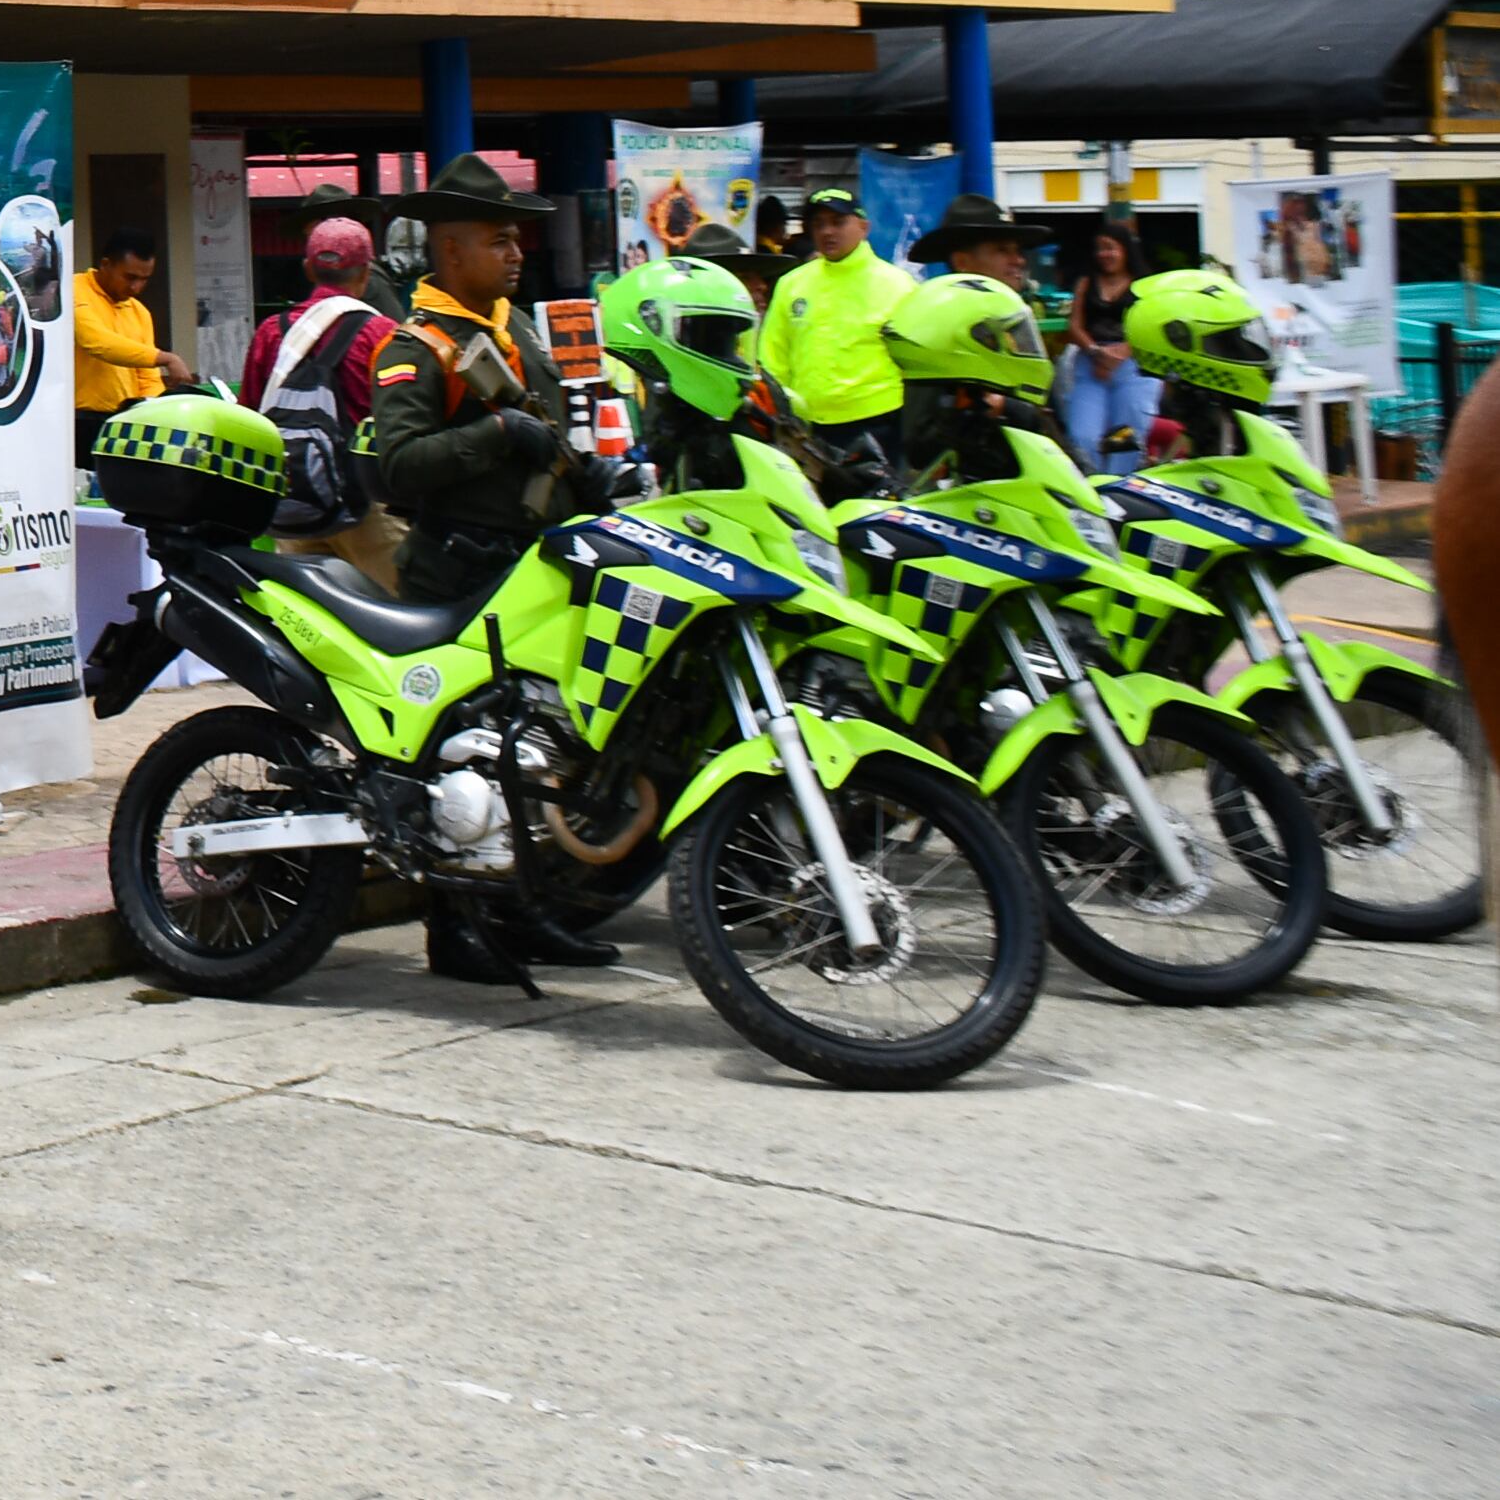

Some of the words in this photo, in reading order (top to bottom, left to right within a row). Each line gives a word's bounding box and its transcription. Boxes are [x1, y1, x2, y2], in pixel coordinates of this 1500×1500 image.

[618, 517, 736, 583] POLICÍA
[901, 510, 1023, 563] POLICÍA
[29, 618, 40, 637] de
[12, 646, 24, 664] de
[6, 659, 74, 692] Patrimonio
